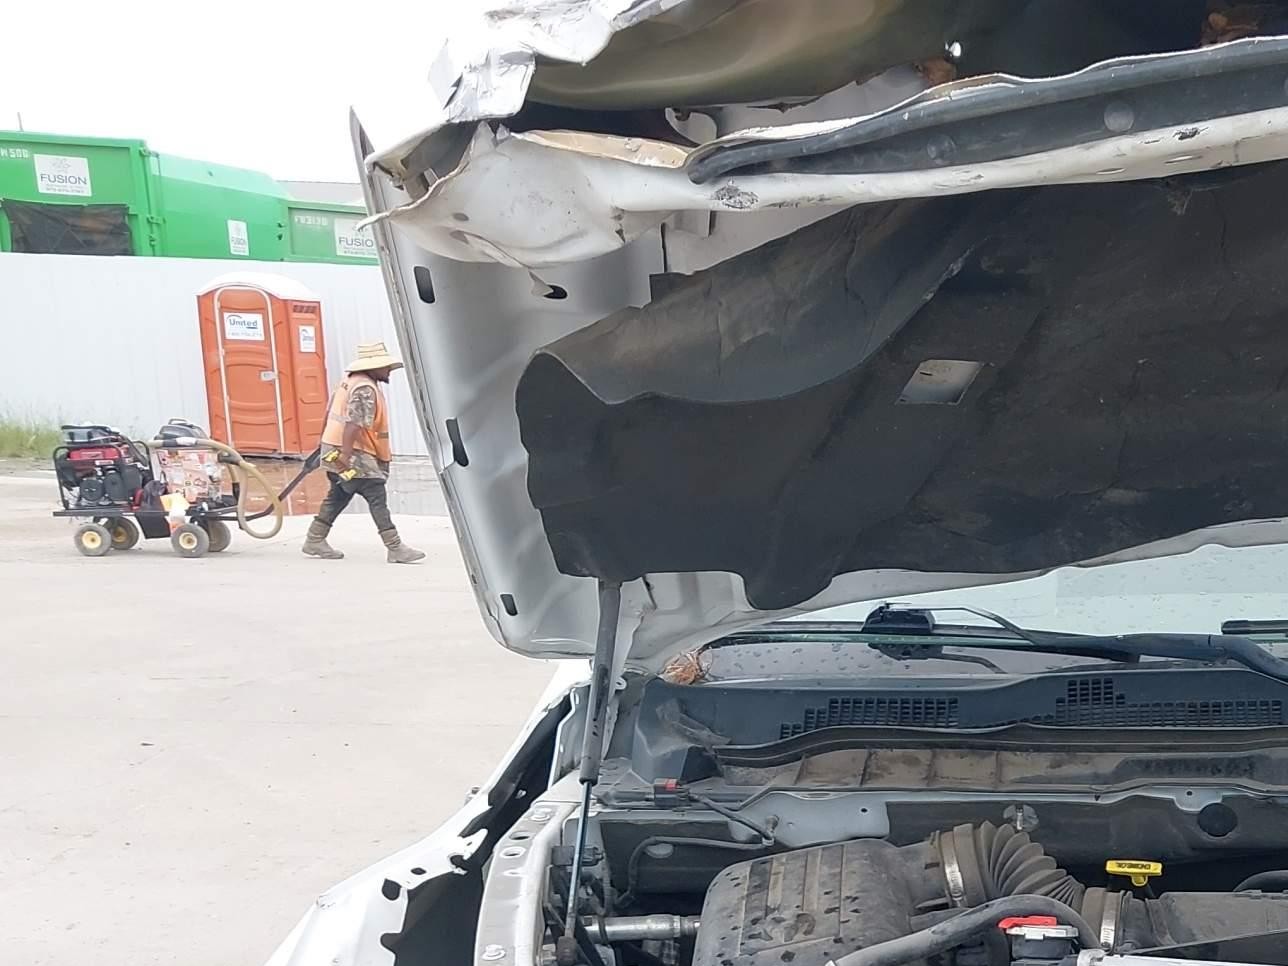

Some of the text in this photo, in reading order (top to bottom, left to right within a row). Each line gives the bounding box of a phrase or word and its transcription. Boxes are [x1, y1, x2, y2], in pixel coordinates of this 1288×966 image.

[40, 174, 87, 185] FUSION
[339, 237, 375, 248] FUSIO
[229, 319, 257, 327] United
